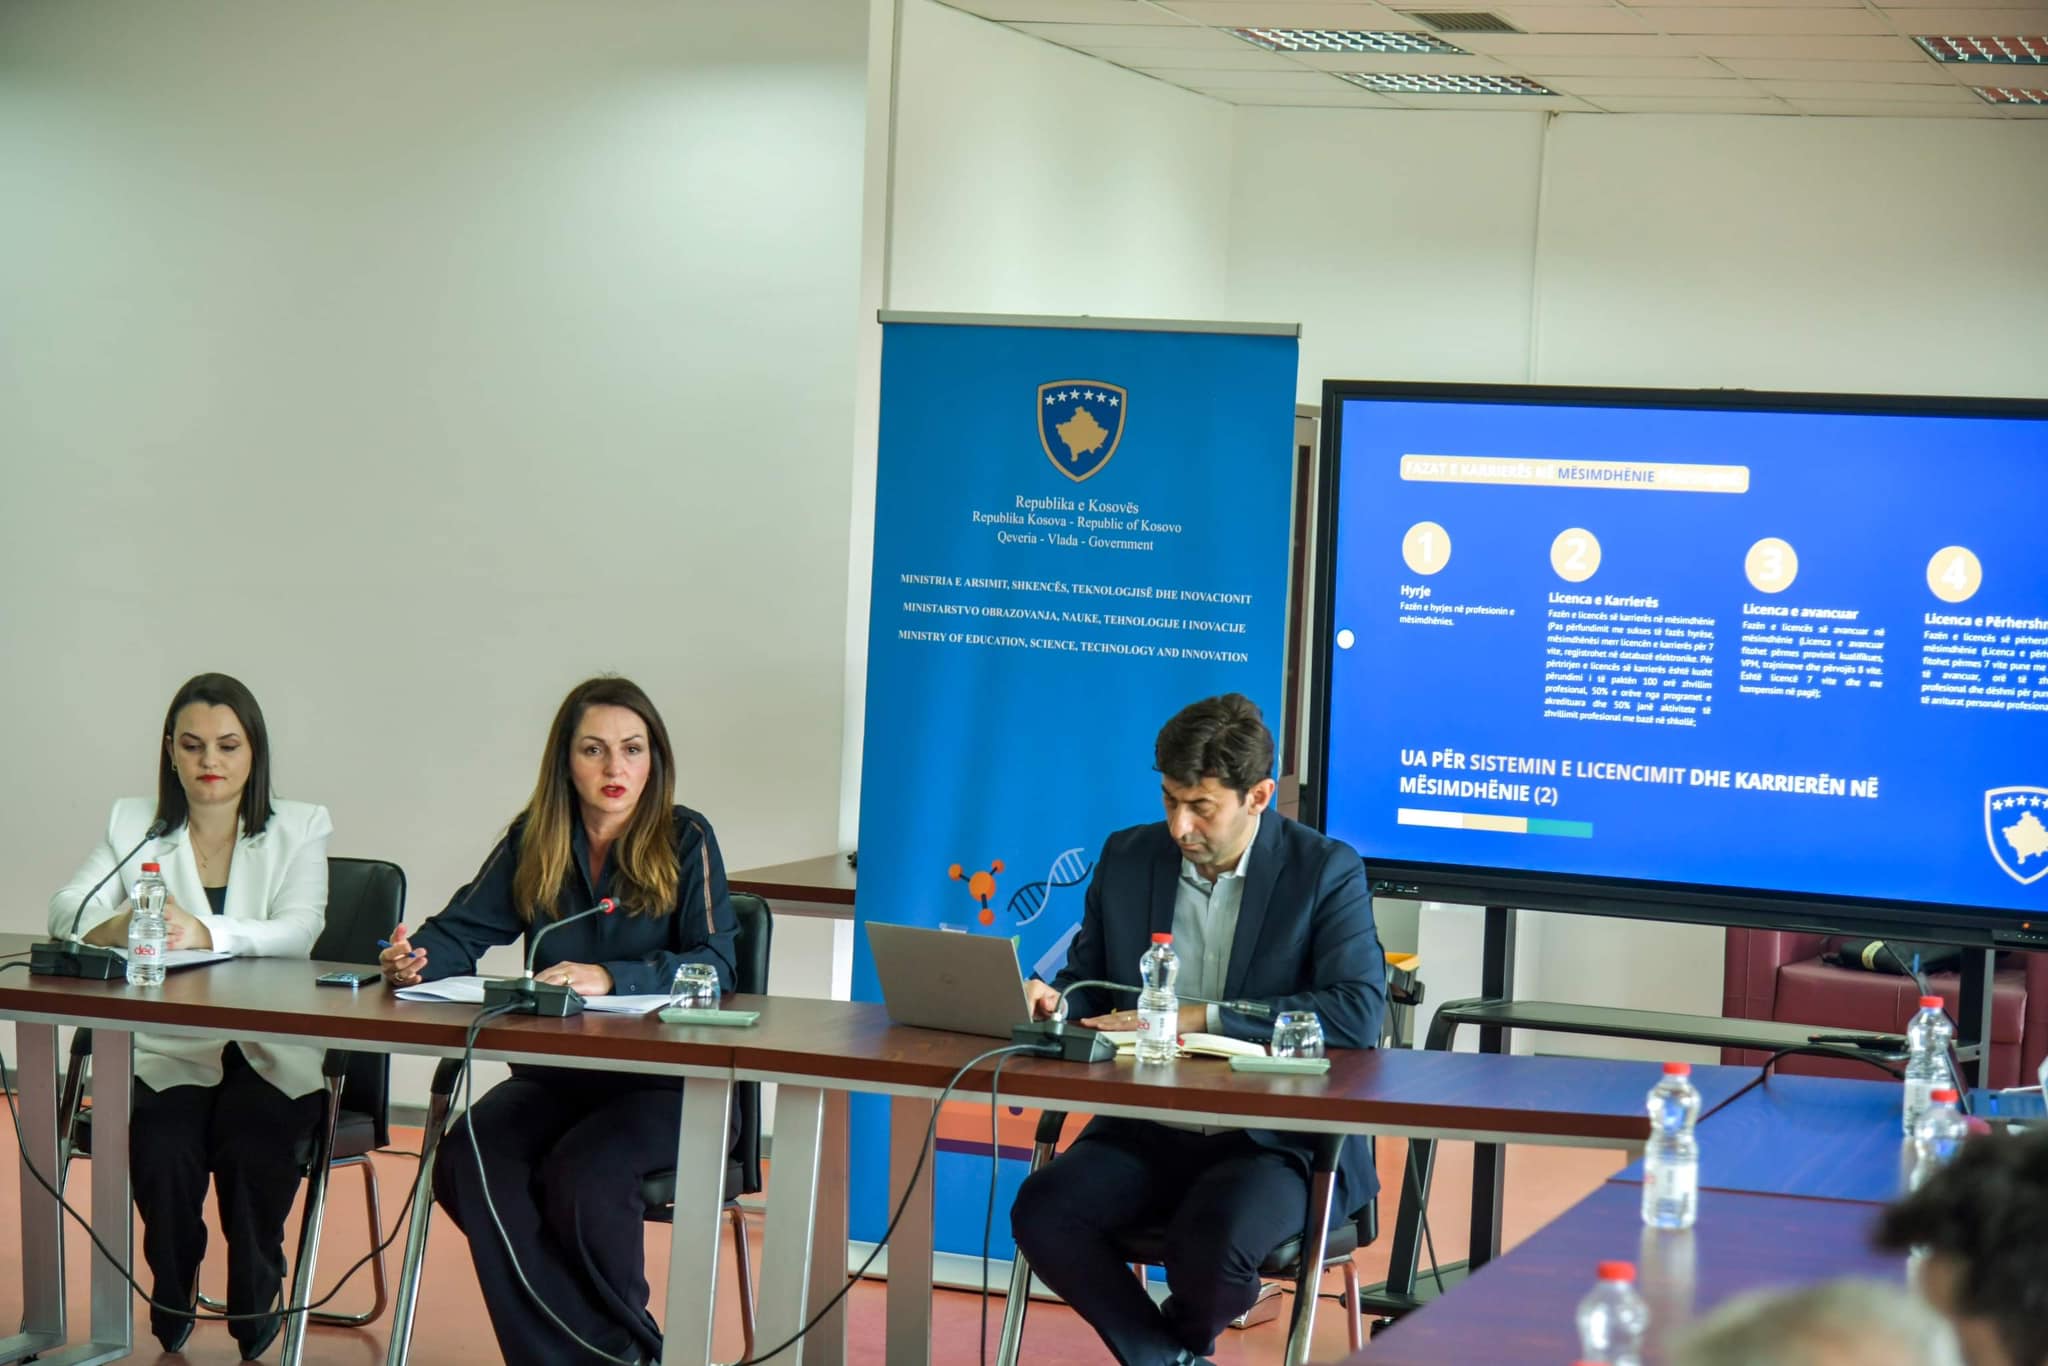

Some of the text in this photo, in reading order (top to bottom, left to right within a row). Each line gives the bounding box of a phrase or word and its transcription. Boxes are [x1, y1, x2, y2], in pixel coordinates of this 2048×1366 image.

[1557, 465, 1656, 483] MËSIMDHËNIE
[1016, 495, 1139, 514] Republika e Kosovës
[973, 511, 1182, 533] Republika Kosova Republic of Kosovo
[997, 530, 1154, 551] Qeveria Vlada Government
[1417, 531, 1433, 563] 1
[1563, 538, 1588, 571] 2
[1758, 547, 1784, 581] 3
[1941, 555, 1968, 591] 4
[901, 574, 1252, 605] MINISTRIA E ARSIMIT, SHKENCËS, TEKNOLOGJISË DHE INOVACIONIT
[1401, 585, 1431, 599] Hyrje
[1400, 601, 1423, 611] Fazën
[1430, 603, 1453, 614] hyrjes
[1465, 605, 1509, 615] profesionin
[1549, 592, 1659, 609] Licenca e Karrierës
[904, 602, 1246, 634] MINISTARSTVO OBRAZOVANJA, NAUKE, TEHNOLOGIJE I INOVACIJE
[1400, 615, 1454, 626] mësimdhënies.
[1743, 603, 1859, 620] Licenca e avancuar
[1924, 613, 1973, 627] Licenca
[1974, 617, 1984, 627] e
[899, 630, 1248, 662] MINISTRY OF EDUCATION, SCIENCE, TECHNOLOGY AND INNOVATION
[1592, 687, 1609, 696] 50%
[1643, 677, 1658, 686] 100
[1614, 701, 1631, 710] 50%
[1401, 748, 1879, 799] UA PËR SISTEMIN E LICENCIMIT DHE KARRIERËN NË
[1400, 774, 1558, 807] MËSIMDHËNIE (2)
